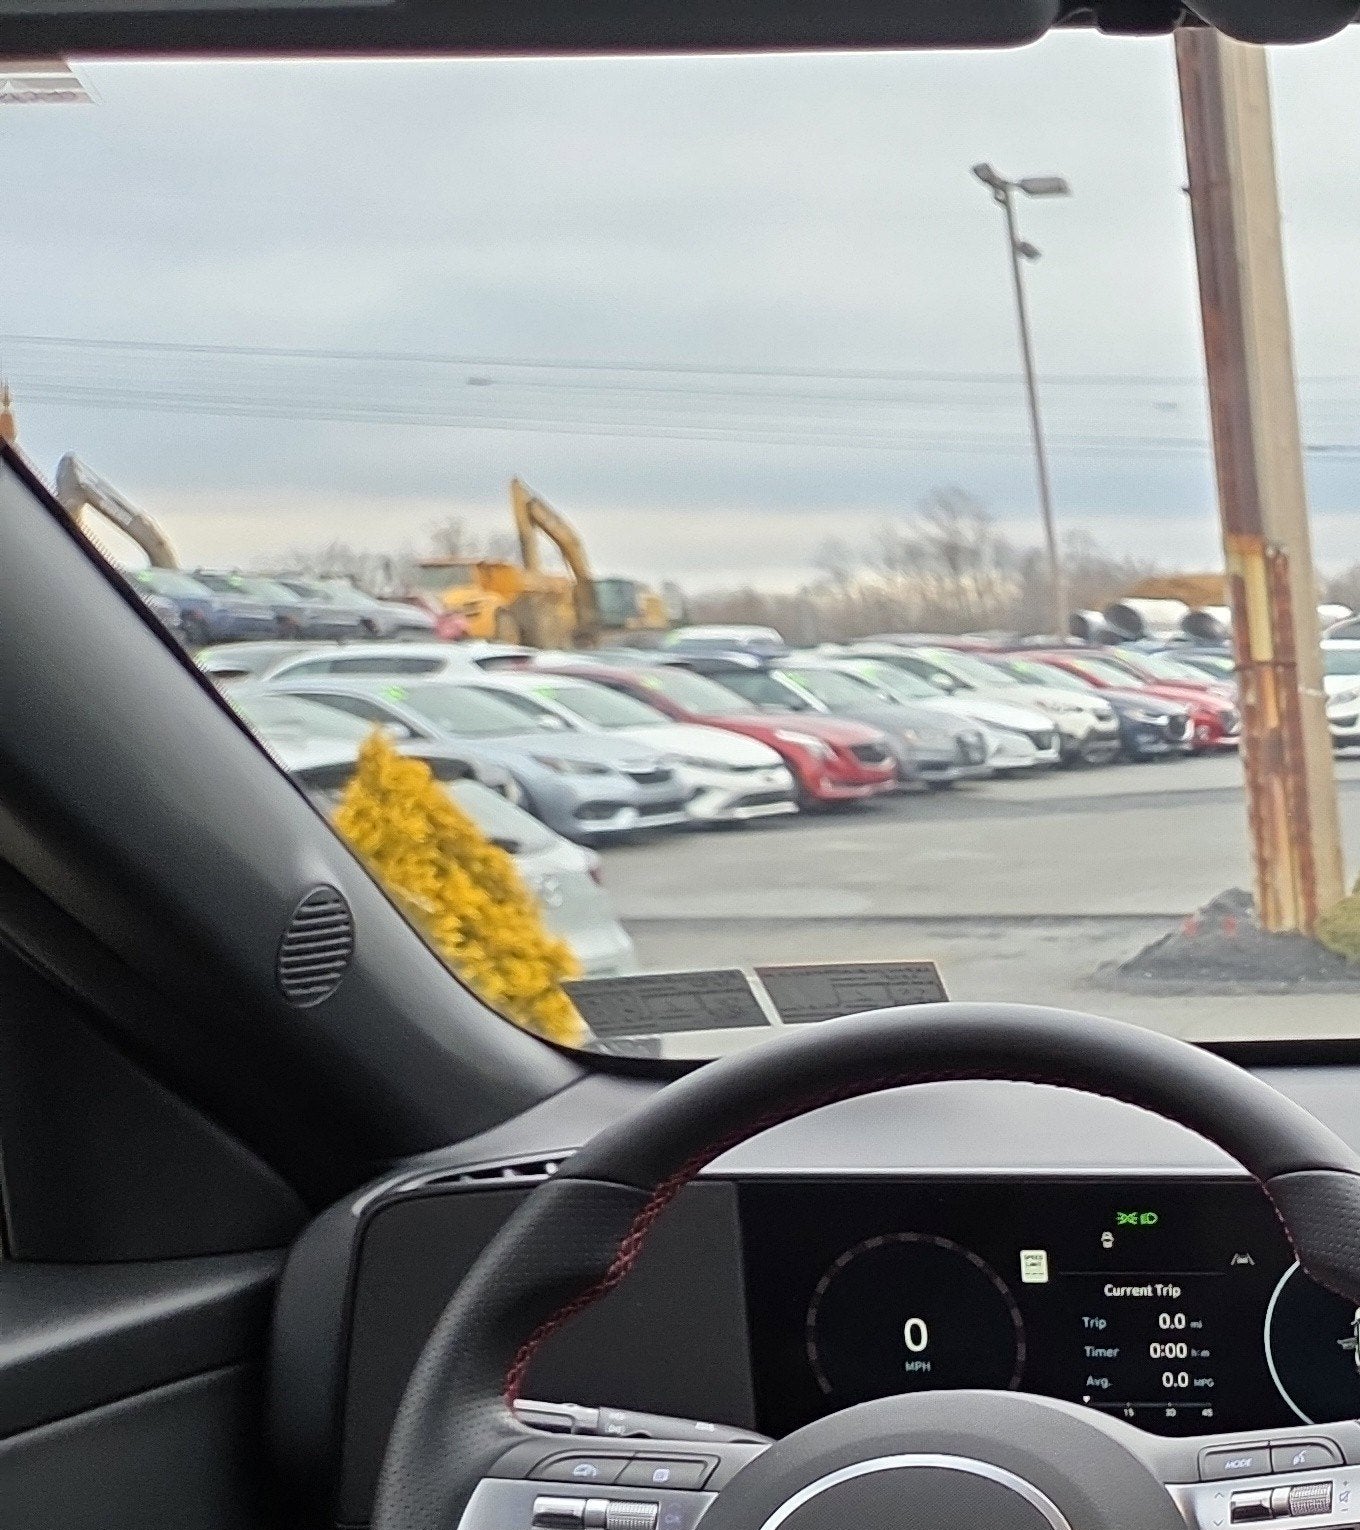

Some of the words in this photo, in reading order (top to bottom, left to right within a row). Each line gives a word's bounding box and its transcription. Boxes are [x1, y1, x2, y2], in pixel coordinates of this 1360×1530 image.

[1103, 1283, 1154, 1297] Current
[1154, 1283, 1181, 1299] Trip
[1082, 1316, 1107, 1331] Trip
[1158, 1312, 1186, 1330] 0.0
[903, 1317, 929, 1353] 0
[1084, 1345, 1120, 1358] Timer
[1149, 1342, 1188, 1359] 0:00
[905, 1361, 931, 1372] MPH
[1086, 1374, 1112, 1390] Avg.
[1161, 1371, 1189, 1388] 0.0
[1224, 1458, 1252, 1469] MODE
